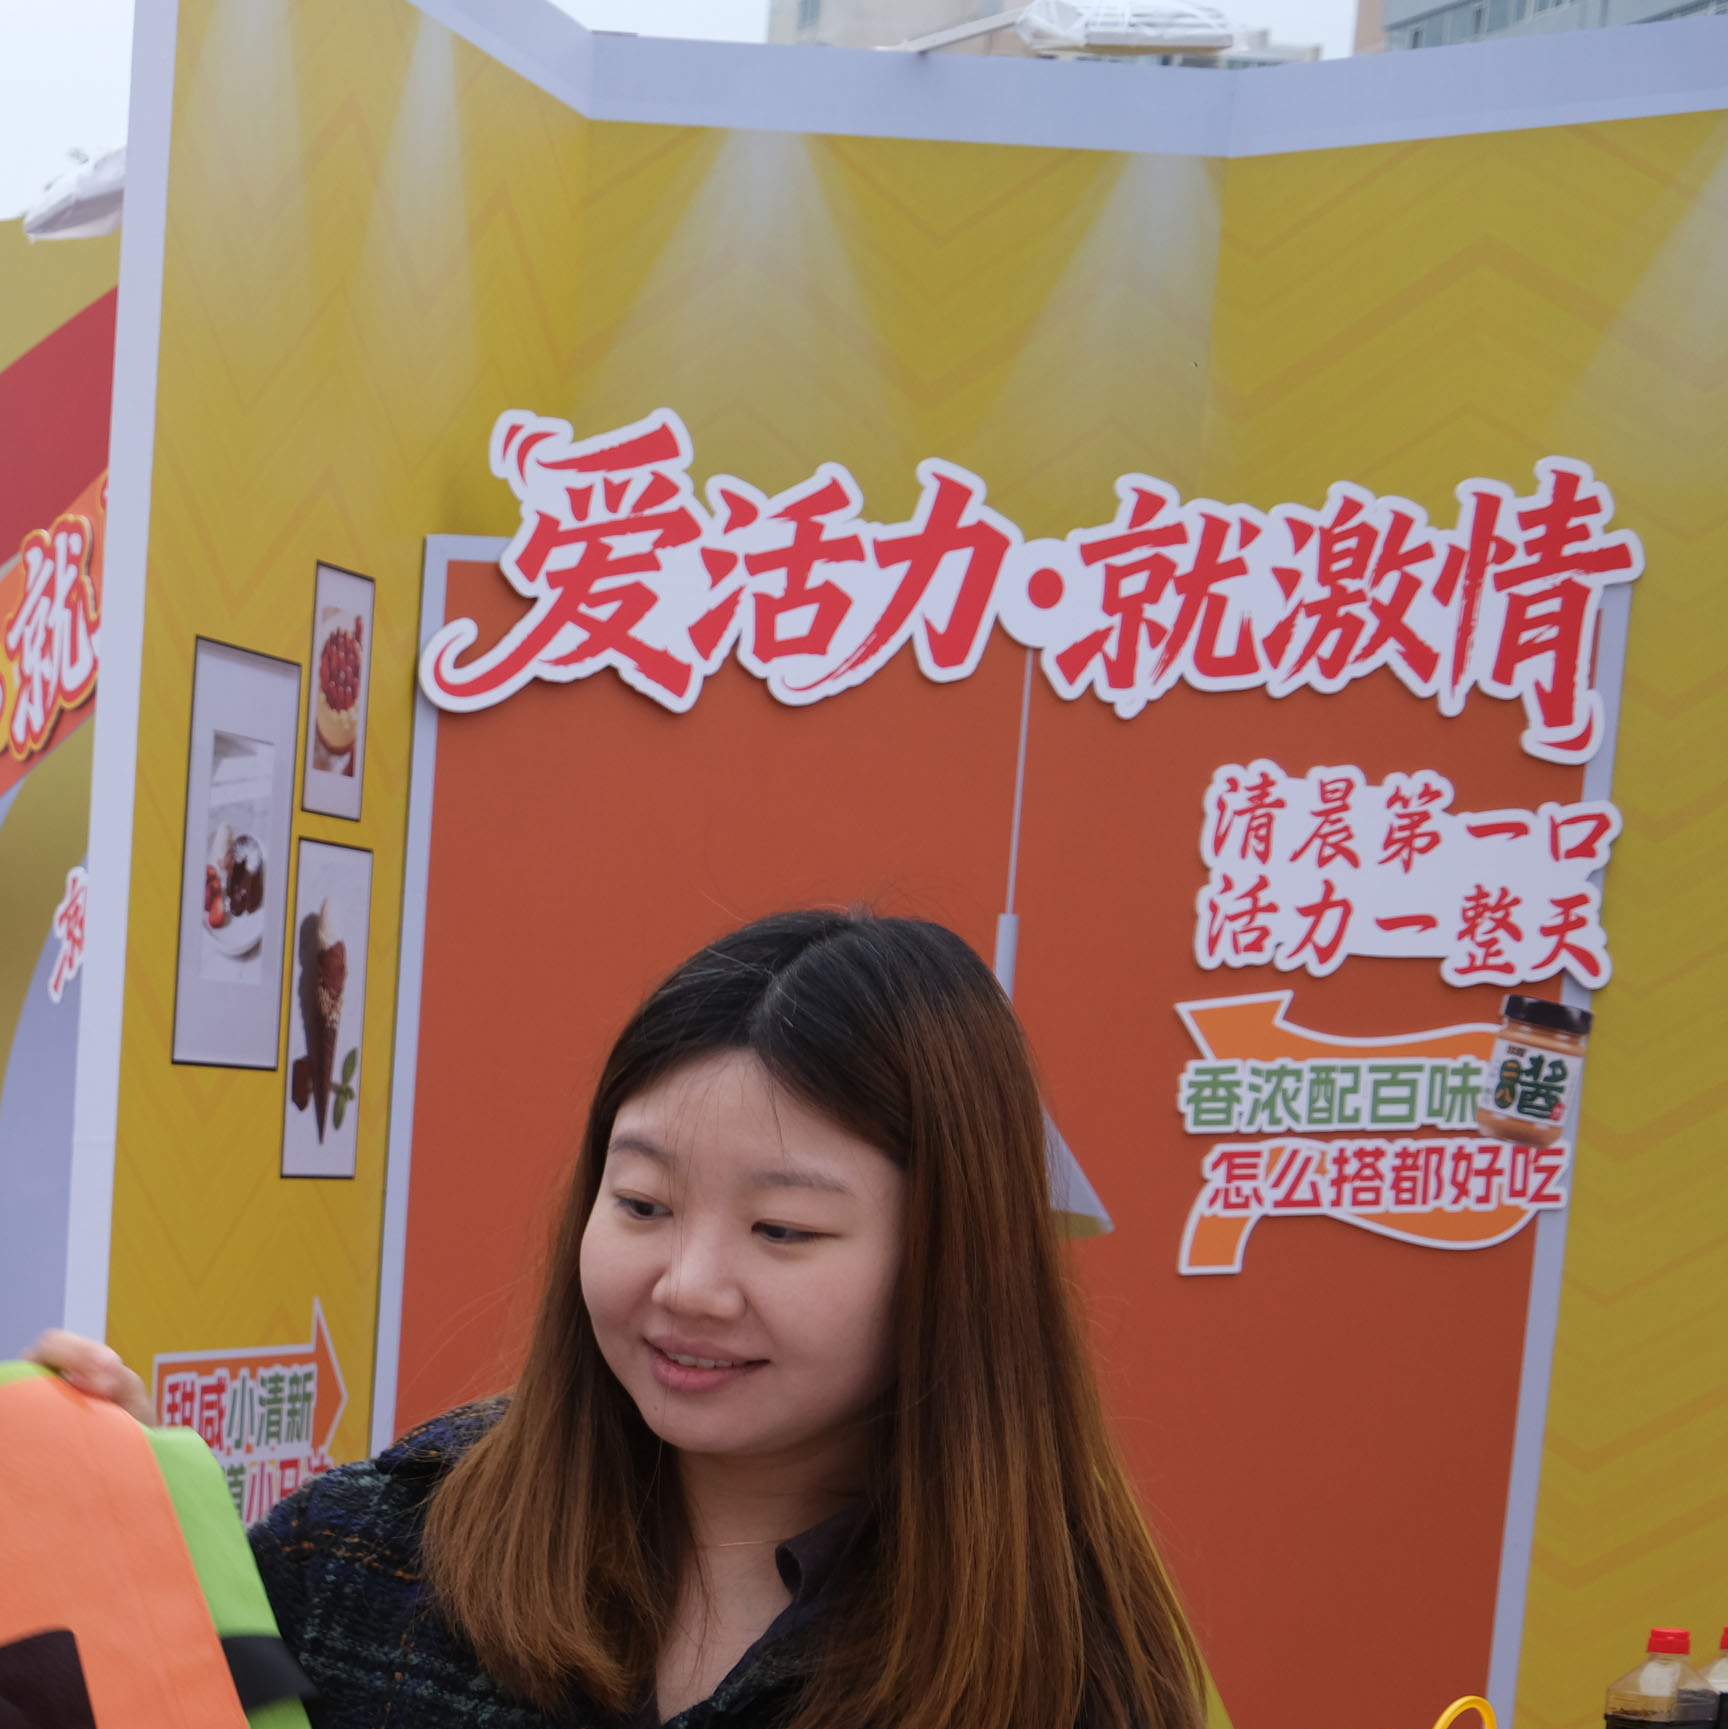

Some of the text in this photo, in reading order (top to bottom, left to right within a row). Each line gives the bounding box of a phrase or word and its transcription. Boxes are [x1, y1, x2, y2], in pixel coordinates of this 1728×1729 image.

[426, 420, 1636, 754] 爱活力·就激情
[1212, 773, 1614, 871] 清晨第一口
[1203, 876, 1612, 978] 活力一整天
[1187, 1061, 1482, 1128] 香浓配百味
[1204, 1146, 1565, 1211] 怎么搭都好吃
